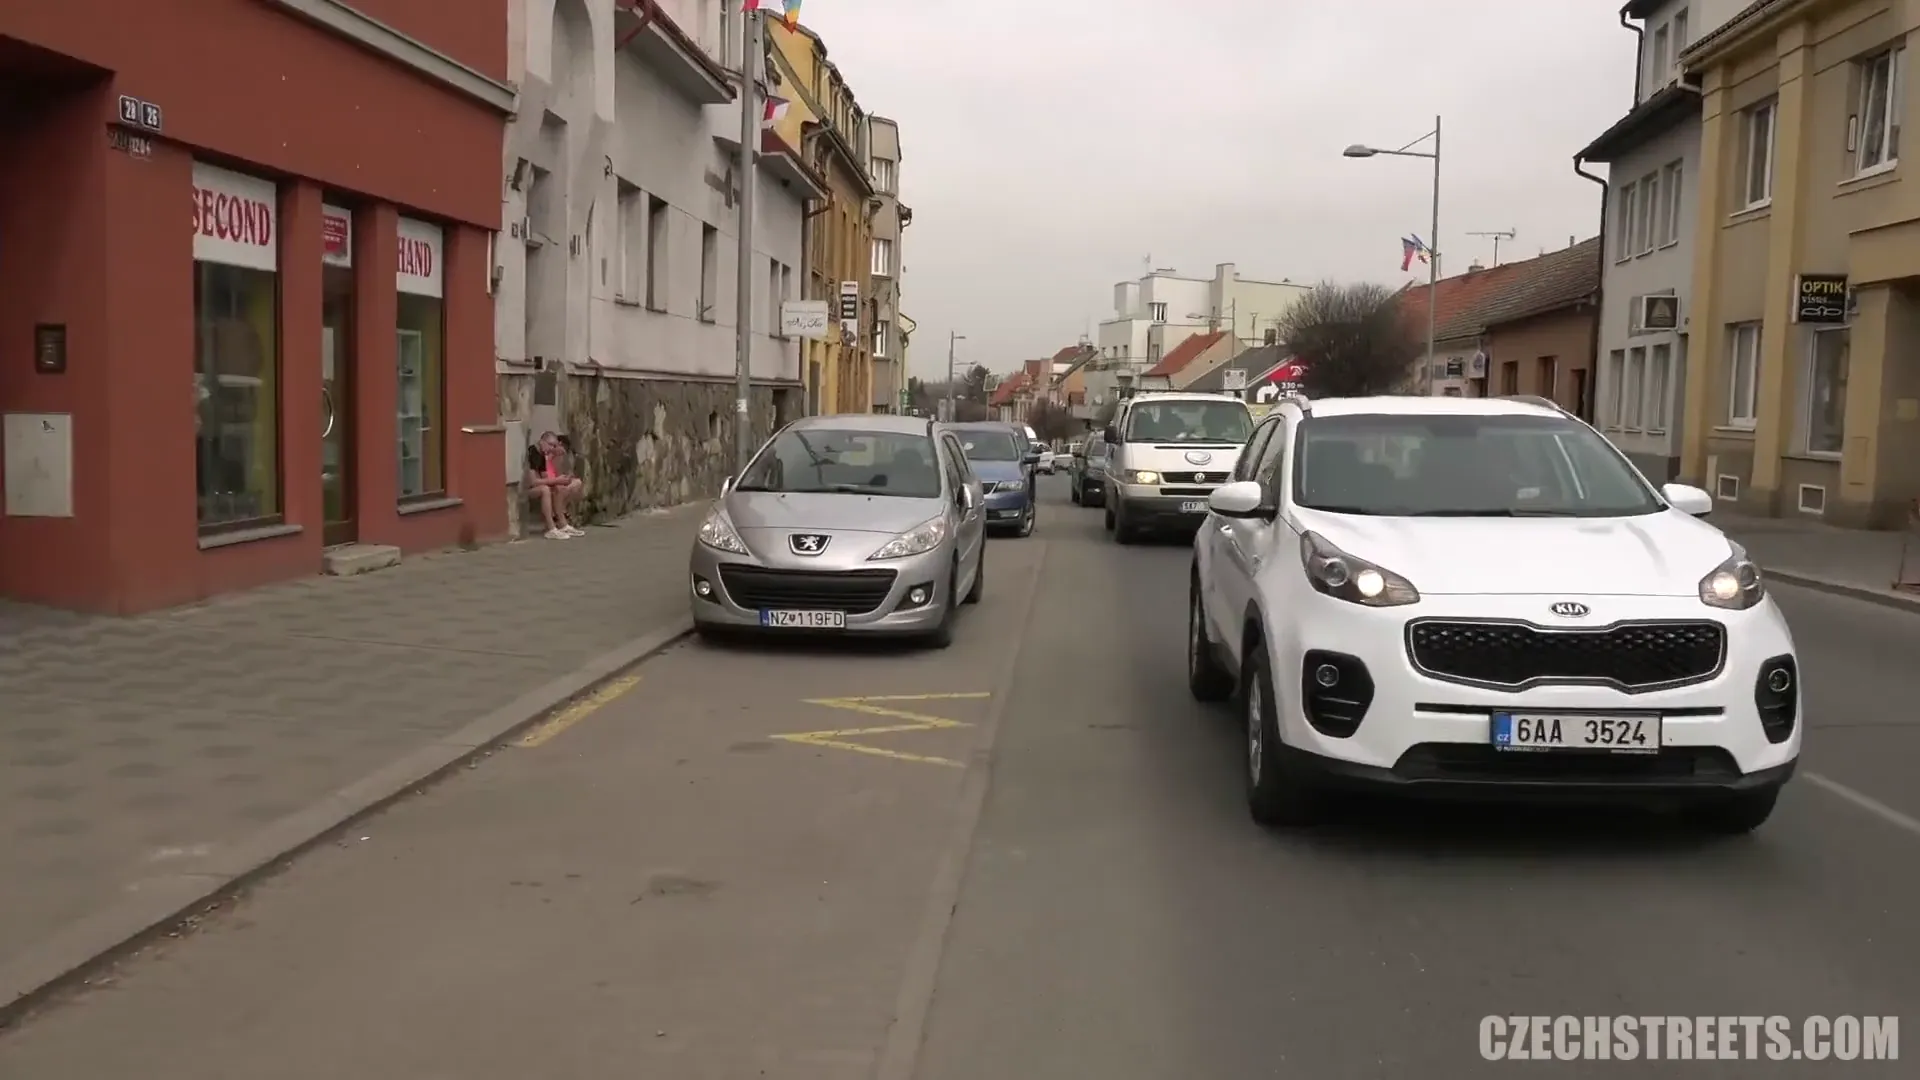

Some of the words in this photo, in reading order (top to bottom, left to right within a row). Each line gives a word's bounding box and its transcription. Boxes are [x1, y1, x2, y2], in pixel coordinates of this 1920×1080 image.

[192, 185, 270, 246] SECOND
[397, 237, 431, 277] HAND
[1802, 281, 1843, 293] OPTIK
[1556, 603, 1585, 613] KIA
[770, 611, 788, 625] NZ
[798, 612, 842, 626] 119FD
[1518, 719, 1563, 743] 6AA
[1585, 720, 1646, 745] 3524
